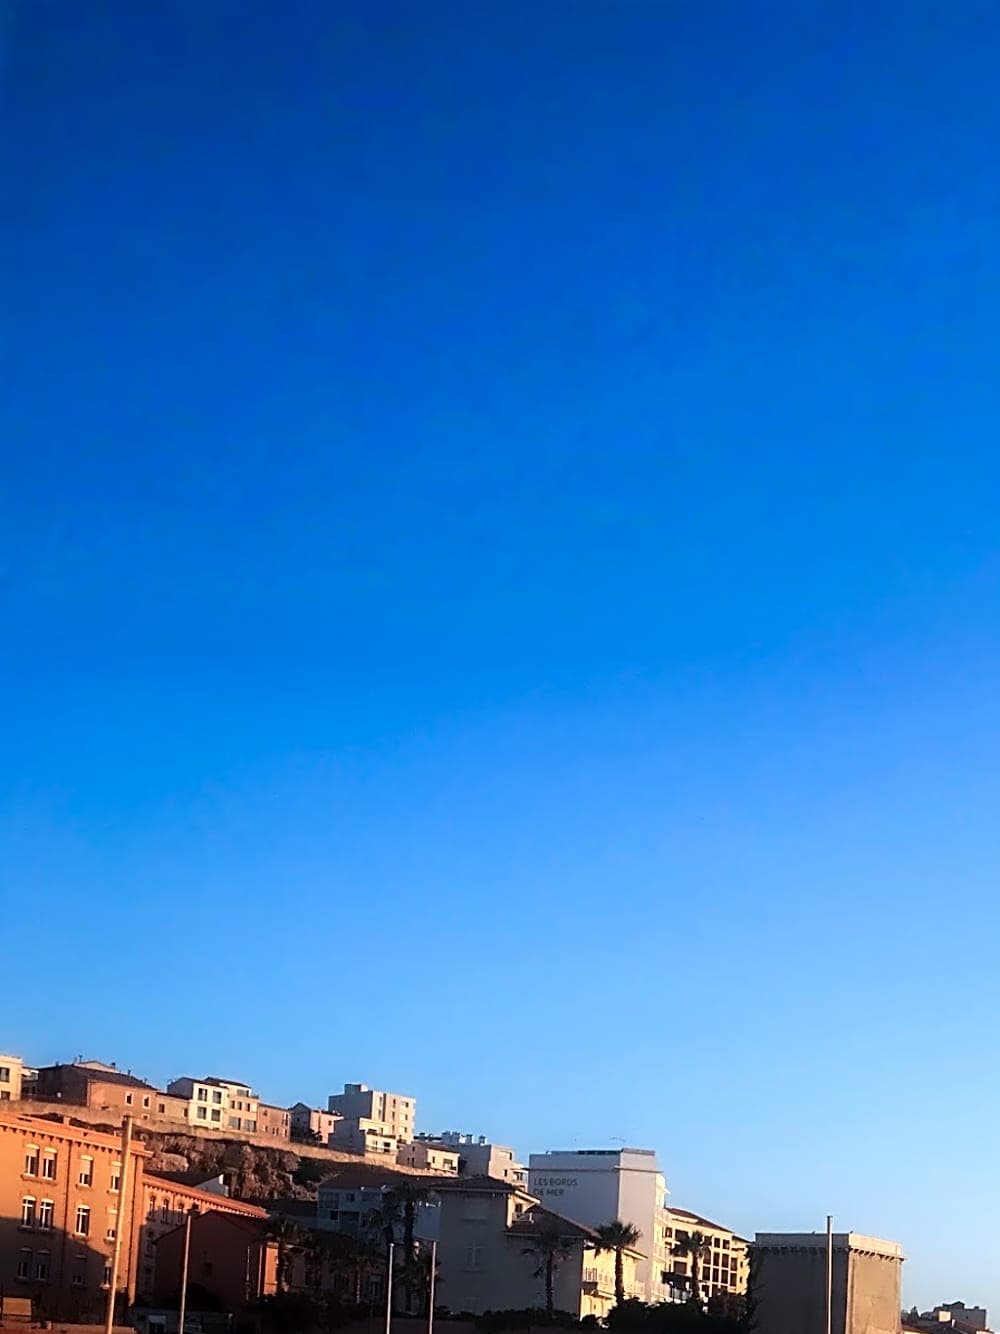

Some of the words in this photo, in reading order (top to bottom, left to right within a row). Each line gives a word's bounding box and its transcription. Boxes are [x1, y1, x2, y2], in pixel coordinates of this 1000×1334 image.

[534, 1177, 548, 1186] LES
[533, 1188, 544, 1196] DE
[546, 1188, 565, 1196] MER
